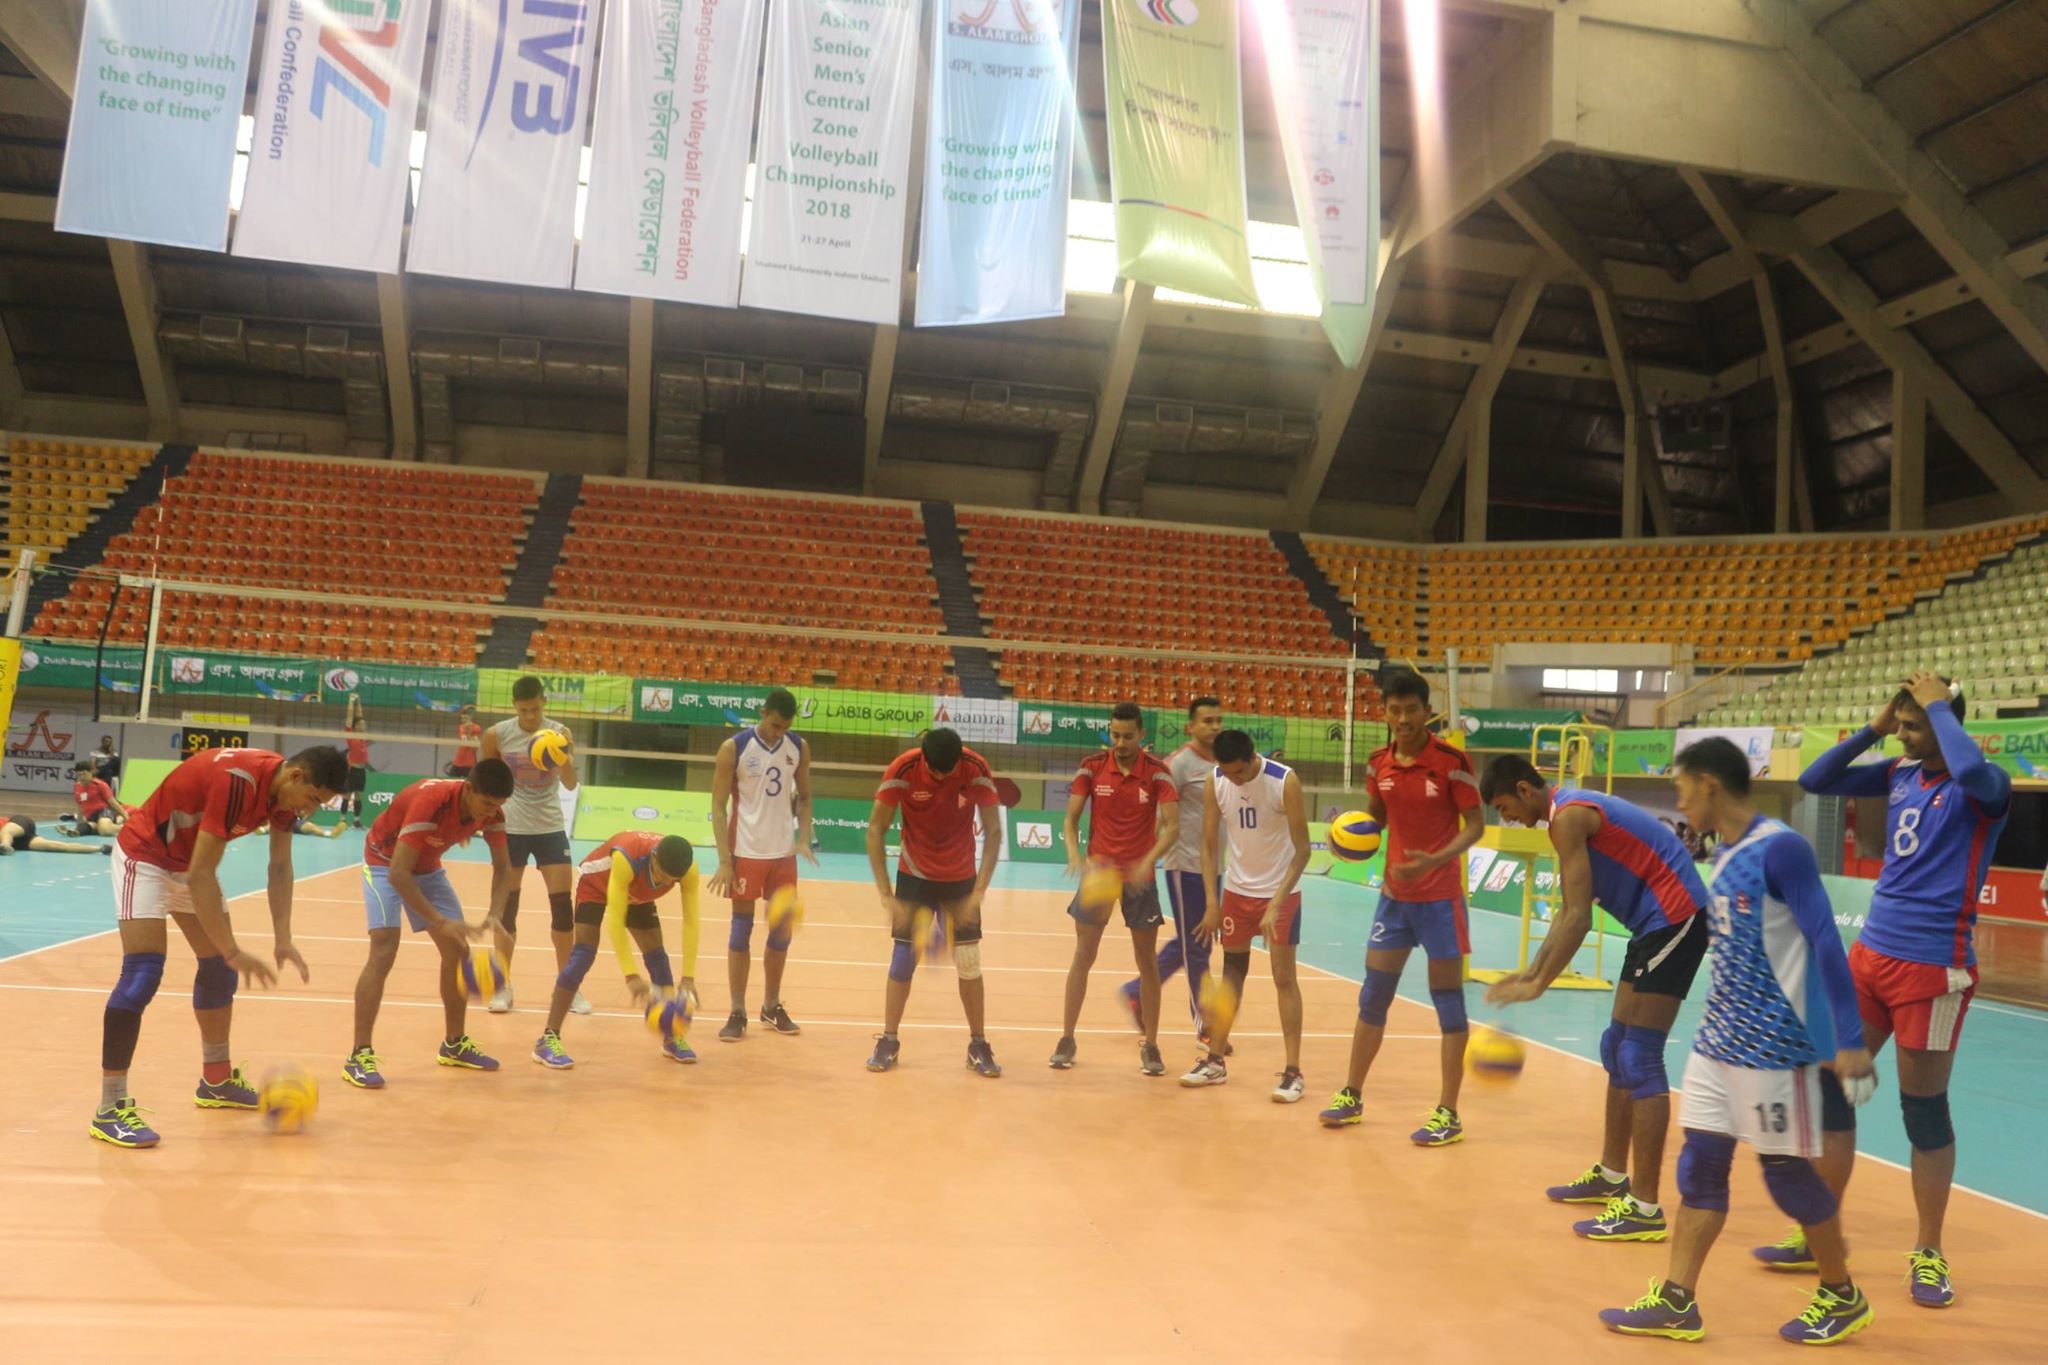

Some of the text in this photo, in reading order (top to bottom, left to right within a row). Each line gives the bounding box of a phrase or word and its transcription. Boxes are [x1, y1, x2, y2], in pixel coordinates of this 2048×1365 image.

[820, 11, 869, 31] Asian
[967, 26, 1007, 42] ALAM
[813, 36, 872, 59] Senior
[193, 51, 236, 72] with
[98, 63, 227, 102] the changing
[269, 26, 302, 160] Confederation
[98, 89, 139, 112] face
[143, 98, 166, 115] of
[804, 89, 871, 112] Central
[811, 117, 859, 138] Zone
[684, 98, 709, 182] Volleyball
[789, 142, 879, 168] Volleyball
[765, 165, 896, 200] Championship
[941, 161, 1053, 182] the changing
[942, 184, 978, 204] face
[982, 189, 1000, 206] of
[805, 199, 851, 219] 2018
[674, 187, 700, 281] Federation
[828, 238, 851, 248] April
[419, 680, 439, 689] Bank
[441, 680, 470, 690] Limited
[826, 704, 925, 723] LABIB GROUP
[953, 712, 1006, 726] aamra
[765, 766, 782, 797] 3
[1239, 807, 1257, 829] 10
[1893, 807, 1921, 857] 8
[1223, 916, 1235, 935] 9
[1371, 921, 1386, 942] 2
[1754, 1102, 1788, 1134] 13
